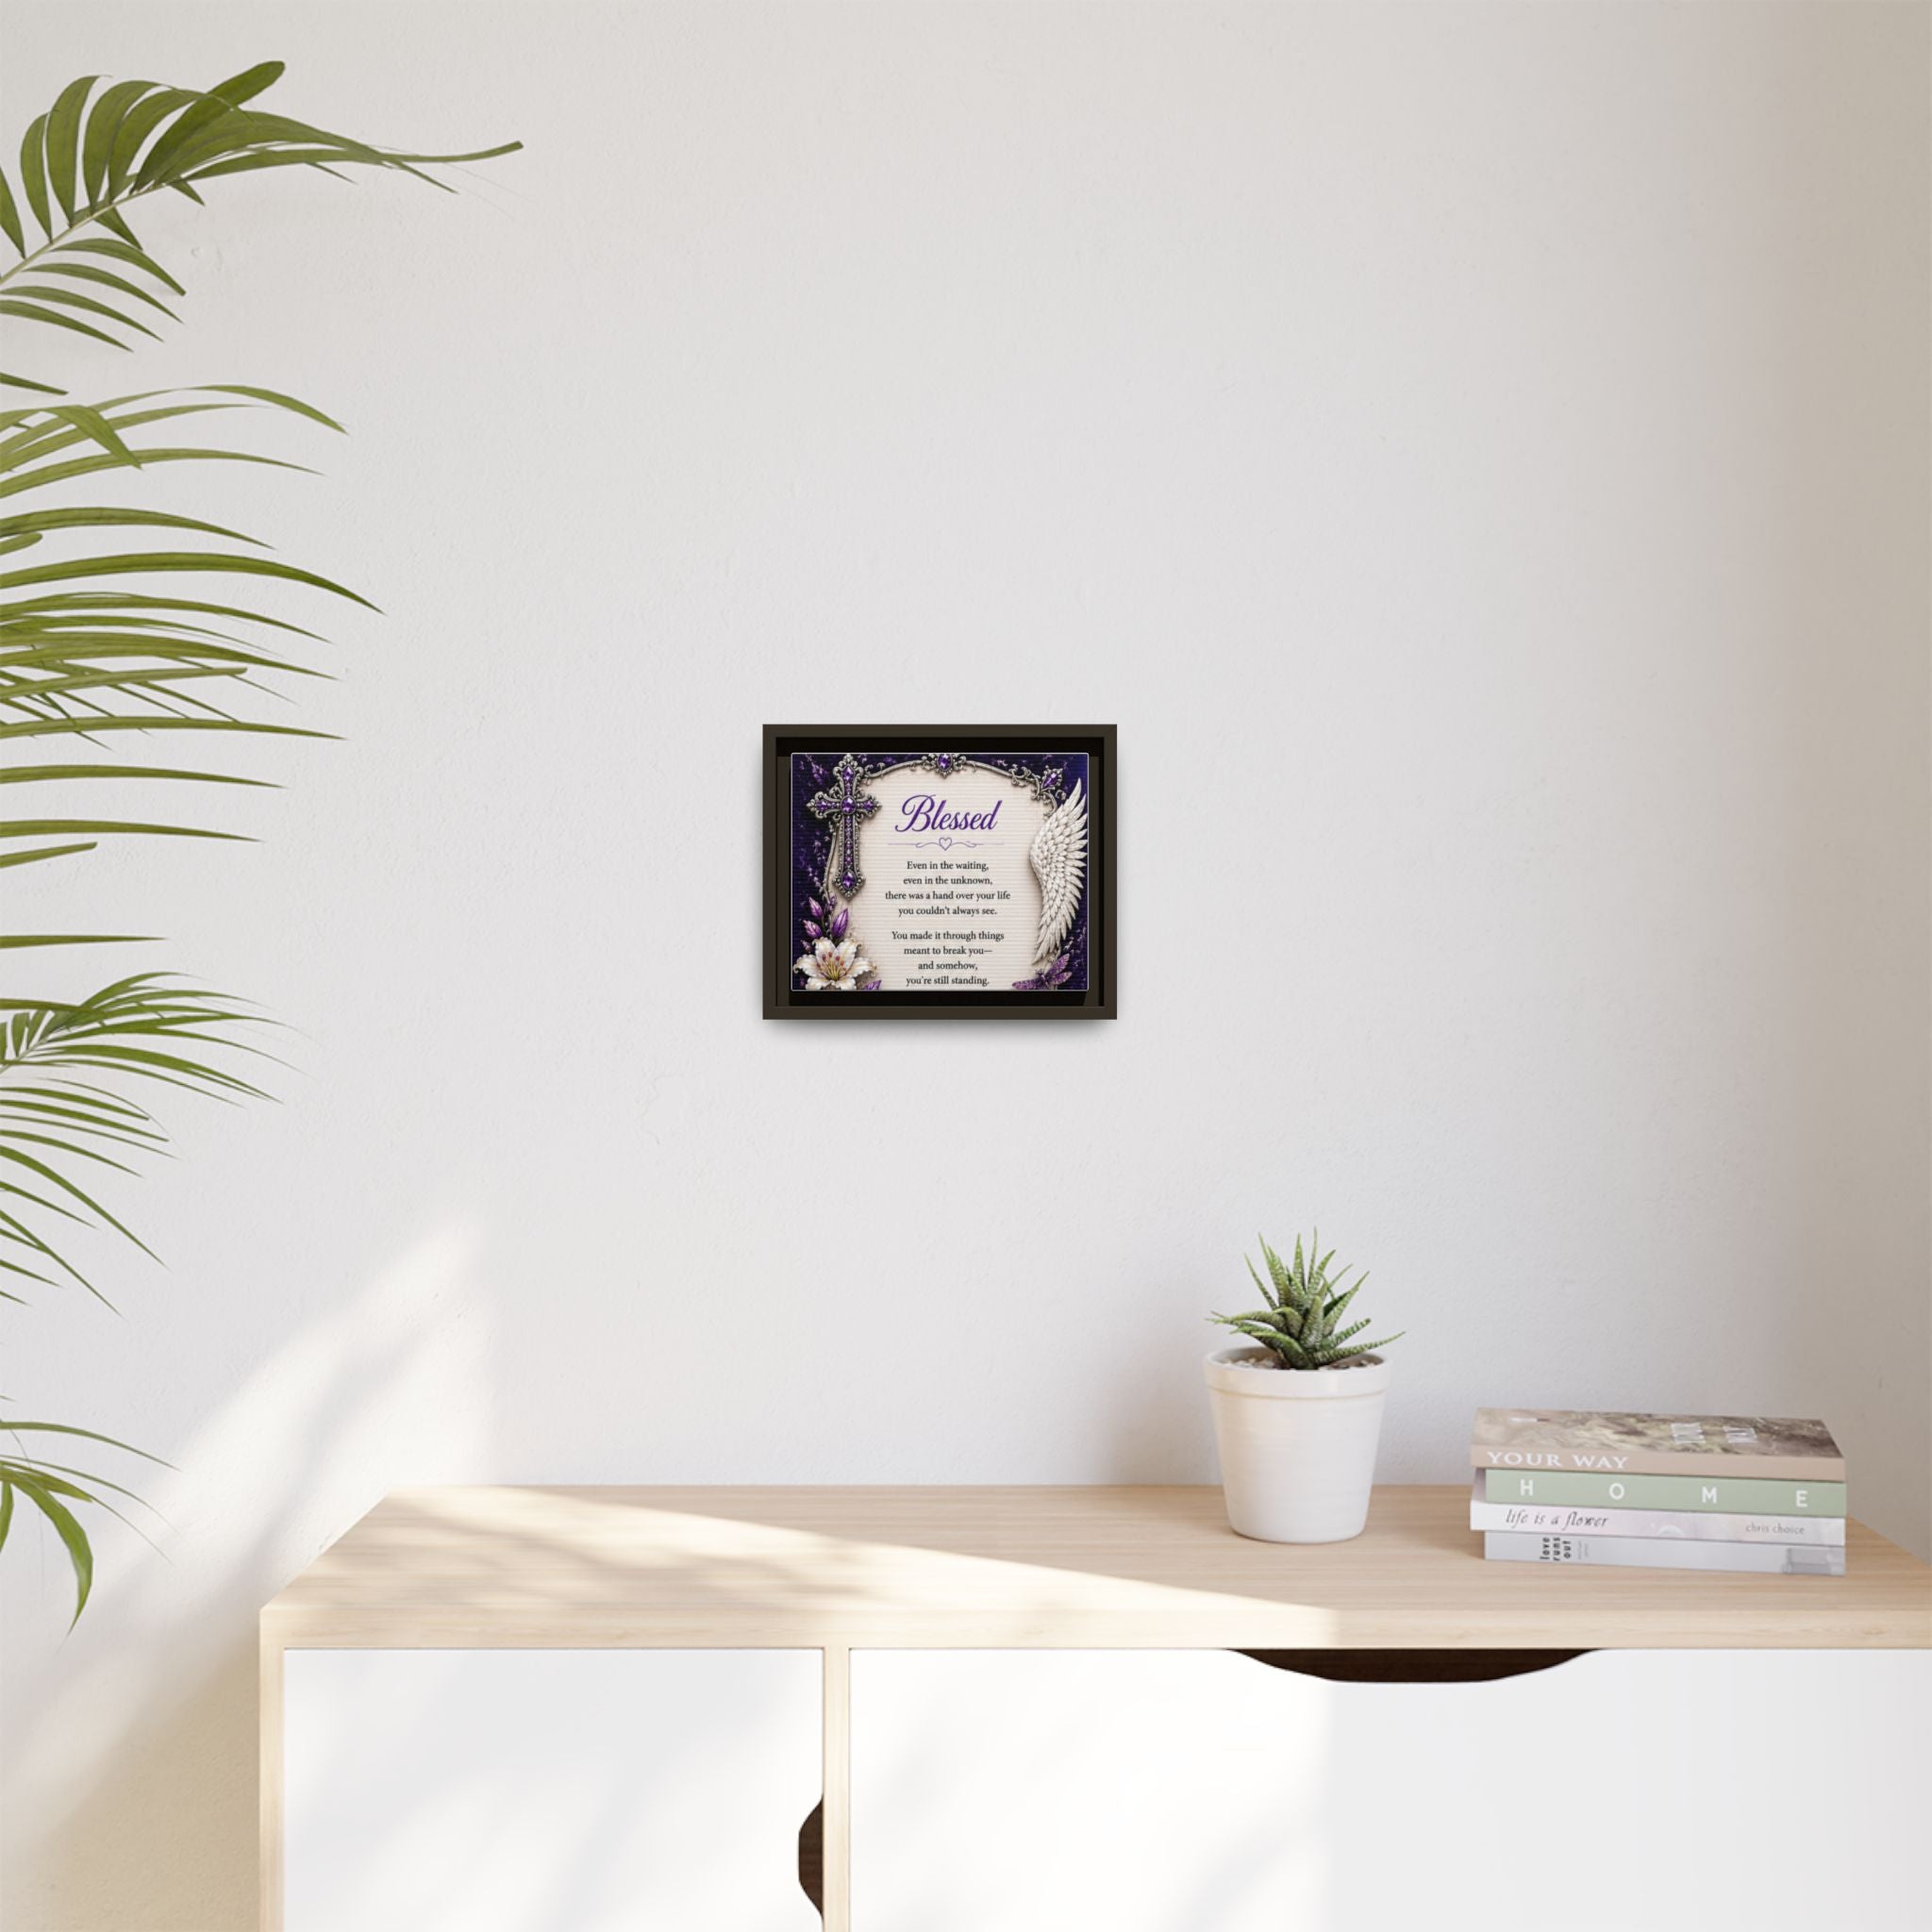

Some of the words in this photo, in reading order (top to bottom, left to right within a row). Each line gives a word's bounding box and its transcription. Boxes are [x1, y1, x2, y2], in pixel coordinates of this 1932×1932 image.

[894, 793, 1003, 833] Blessed
[907, 860, 927, 870] Even
[929, 860, 939, 870] in
[940, 860, 954, 870] the
[955, 860, 990, 873] waiting,
[903, 876, 923, 885] even
[924, 875, 933, 885] in
[935, 875, 948, 885] the
[950, 875, 993, 886] unknown,
[885, 891, 907, 900] there
[932, 891, 954, 900] hand
[975, 892, 995, 902] your
[996, 891, 1010, 900] life
[898, 908, 914, 917] you
[915, 906, 950, 915] couldn't
[952, 906, 979, 917] always
[891, 931, 908, 940] You
[909, 931, 933, 940] made
[935, 931, 941, 940] it
[942, 931, 976, 942] through
[978, 931, 1005, 942] things
[904, 946, 930, 955] meant
[932, 946, 941, 955] to
[942, 945, 966, 955] break
[918, 961, 934, 970] and
[936, 961, 978, 971] somehow,
[906, 975, 932, 987] you're
[933, 975, 949, 985] still
[951, 975, 990, 987] standing.
[1487, 1451, 1562, 1466] YOUR
[1573, 1455, 1628, 1469] WAY
[1519, 1478, 1808, 1508] HOME
[1506, 1508, 1528, 1528] life
[1534, 1512, 1545, 1524] is
[1551, 1515, 1559, 1525] a
[1561, 1511, 1609, 1531] flower
[1745, 1522, 1770, 1533] chris
[1773, 1523, 1805, 1536] choice
[1540, 1537, 1550, 1560] love
[1553, 1537, 1561, 1561] runs
[1562, 1541, 1572, 1558] out
